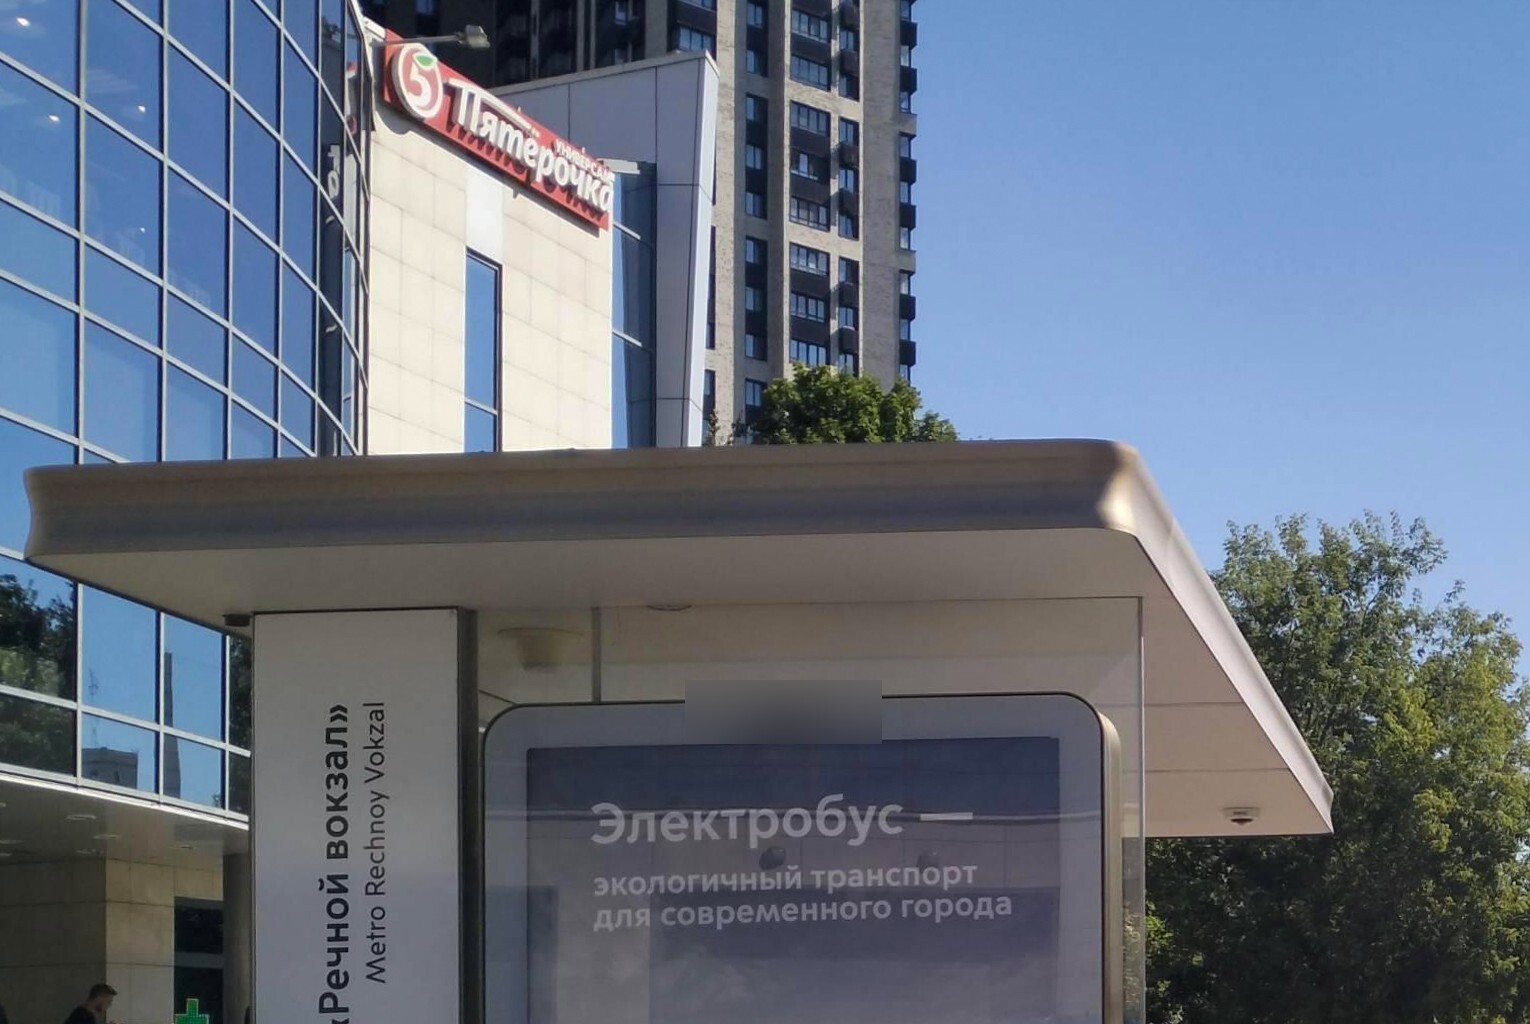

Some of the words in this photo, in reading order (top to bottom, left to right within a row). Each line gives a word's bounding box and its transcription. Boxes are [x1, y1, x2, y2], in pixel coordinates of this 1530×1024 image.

[324, 702, 350, 860] вокзал»
[362, 702, 386, 783] Vokzal
[364, 790, 390, 897] Rechnoy
[590, 793, 904, 849] Электробус
[593, 864, 802, 897] экологичный
[810, 863, 979, 894] транспорт
[593, 906, 652, 932] для
[660, 900, 893, 930] современного
[901, 896, 1012, 923] города
[365, 906, 387, 985] Metro
